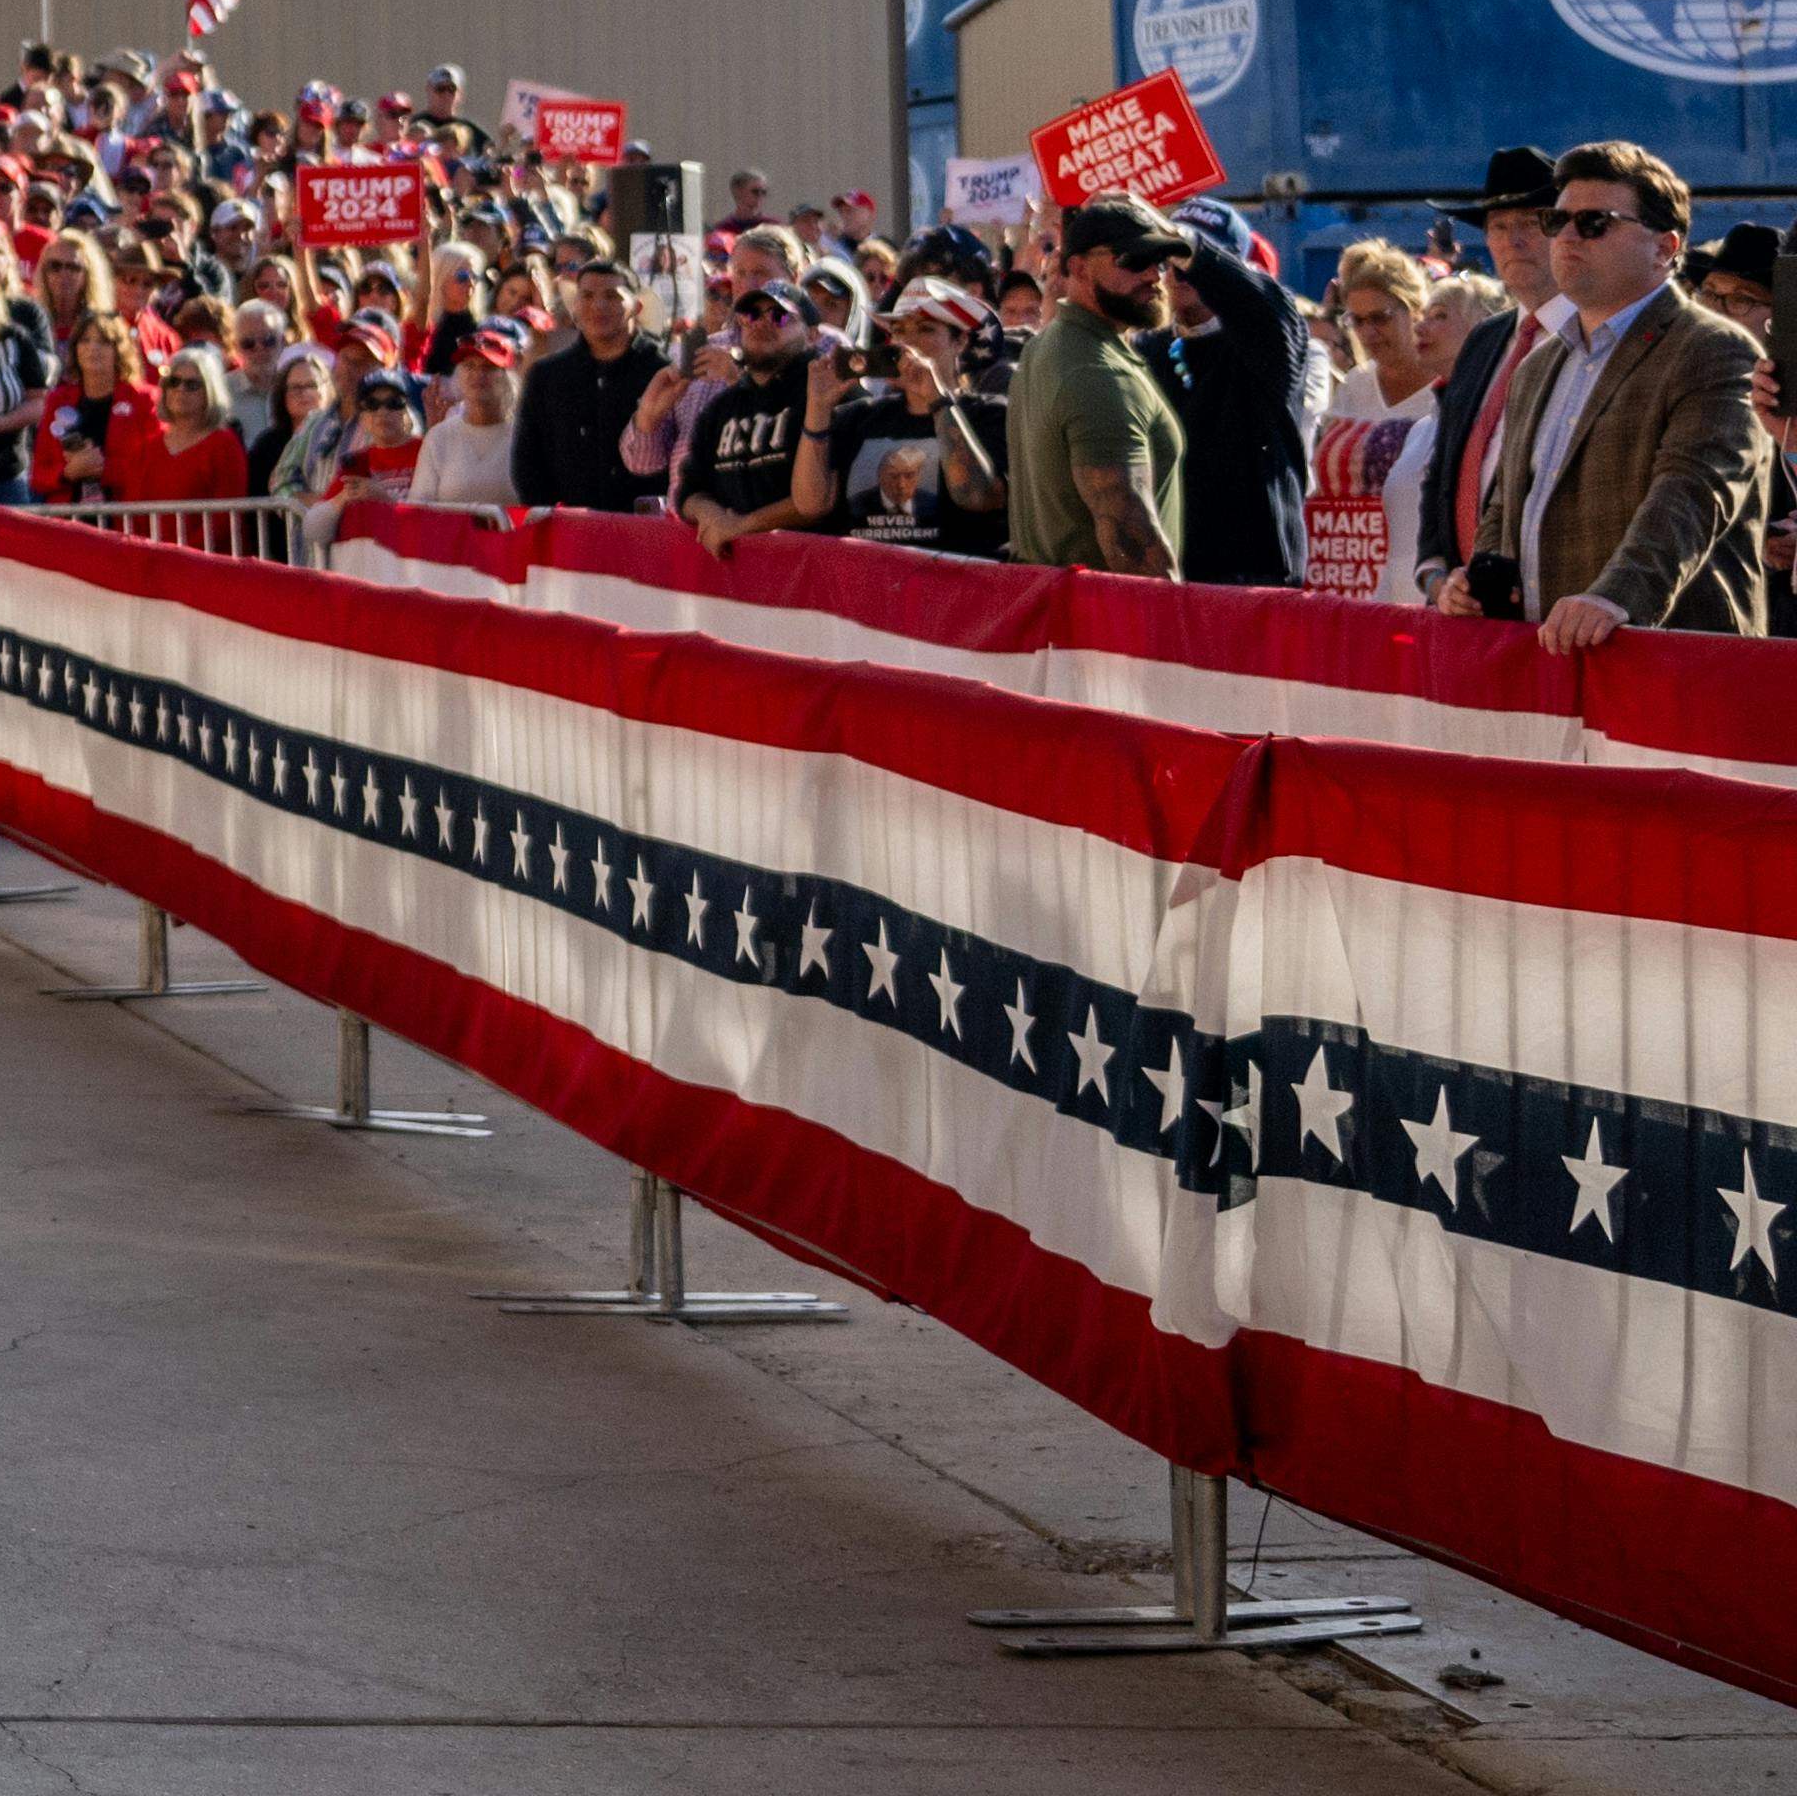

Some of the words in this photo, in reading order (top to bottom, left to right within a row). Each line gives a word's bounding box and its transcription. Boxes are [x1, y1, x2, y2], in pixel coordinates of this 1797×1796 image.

[1142, 5, 1251, 44] TRENDSETTER
[542, 110, 616, 129] TRUMP
[1066, 96, 1144, 147] MAKE
[548, 127, 604, 146] 2024
[1058, 111, 1178, 179] AMERICA
[957, 167, 1021, 189] TRUMP
[1078, 138, 1166, 193] GREAT
[307, 175, 414, 202] TRUMP
[1105, 160, 1183, 199] AIN!
[966, 183, 1012, 203] 2024
[322, 197, 399, 221] 2024
[1312, 510, 1383, 535] MAKE
[1308, 537, 1387, 562] MERIC
